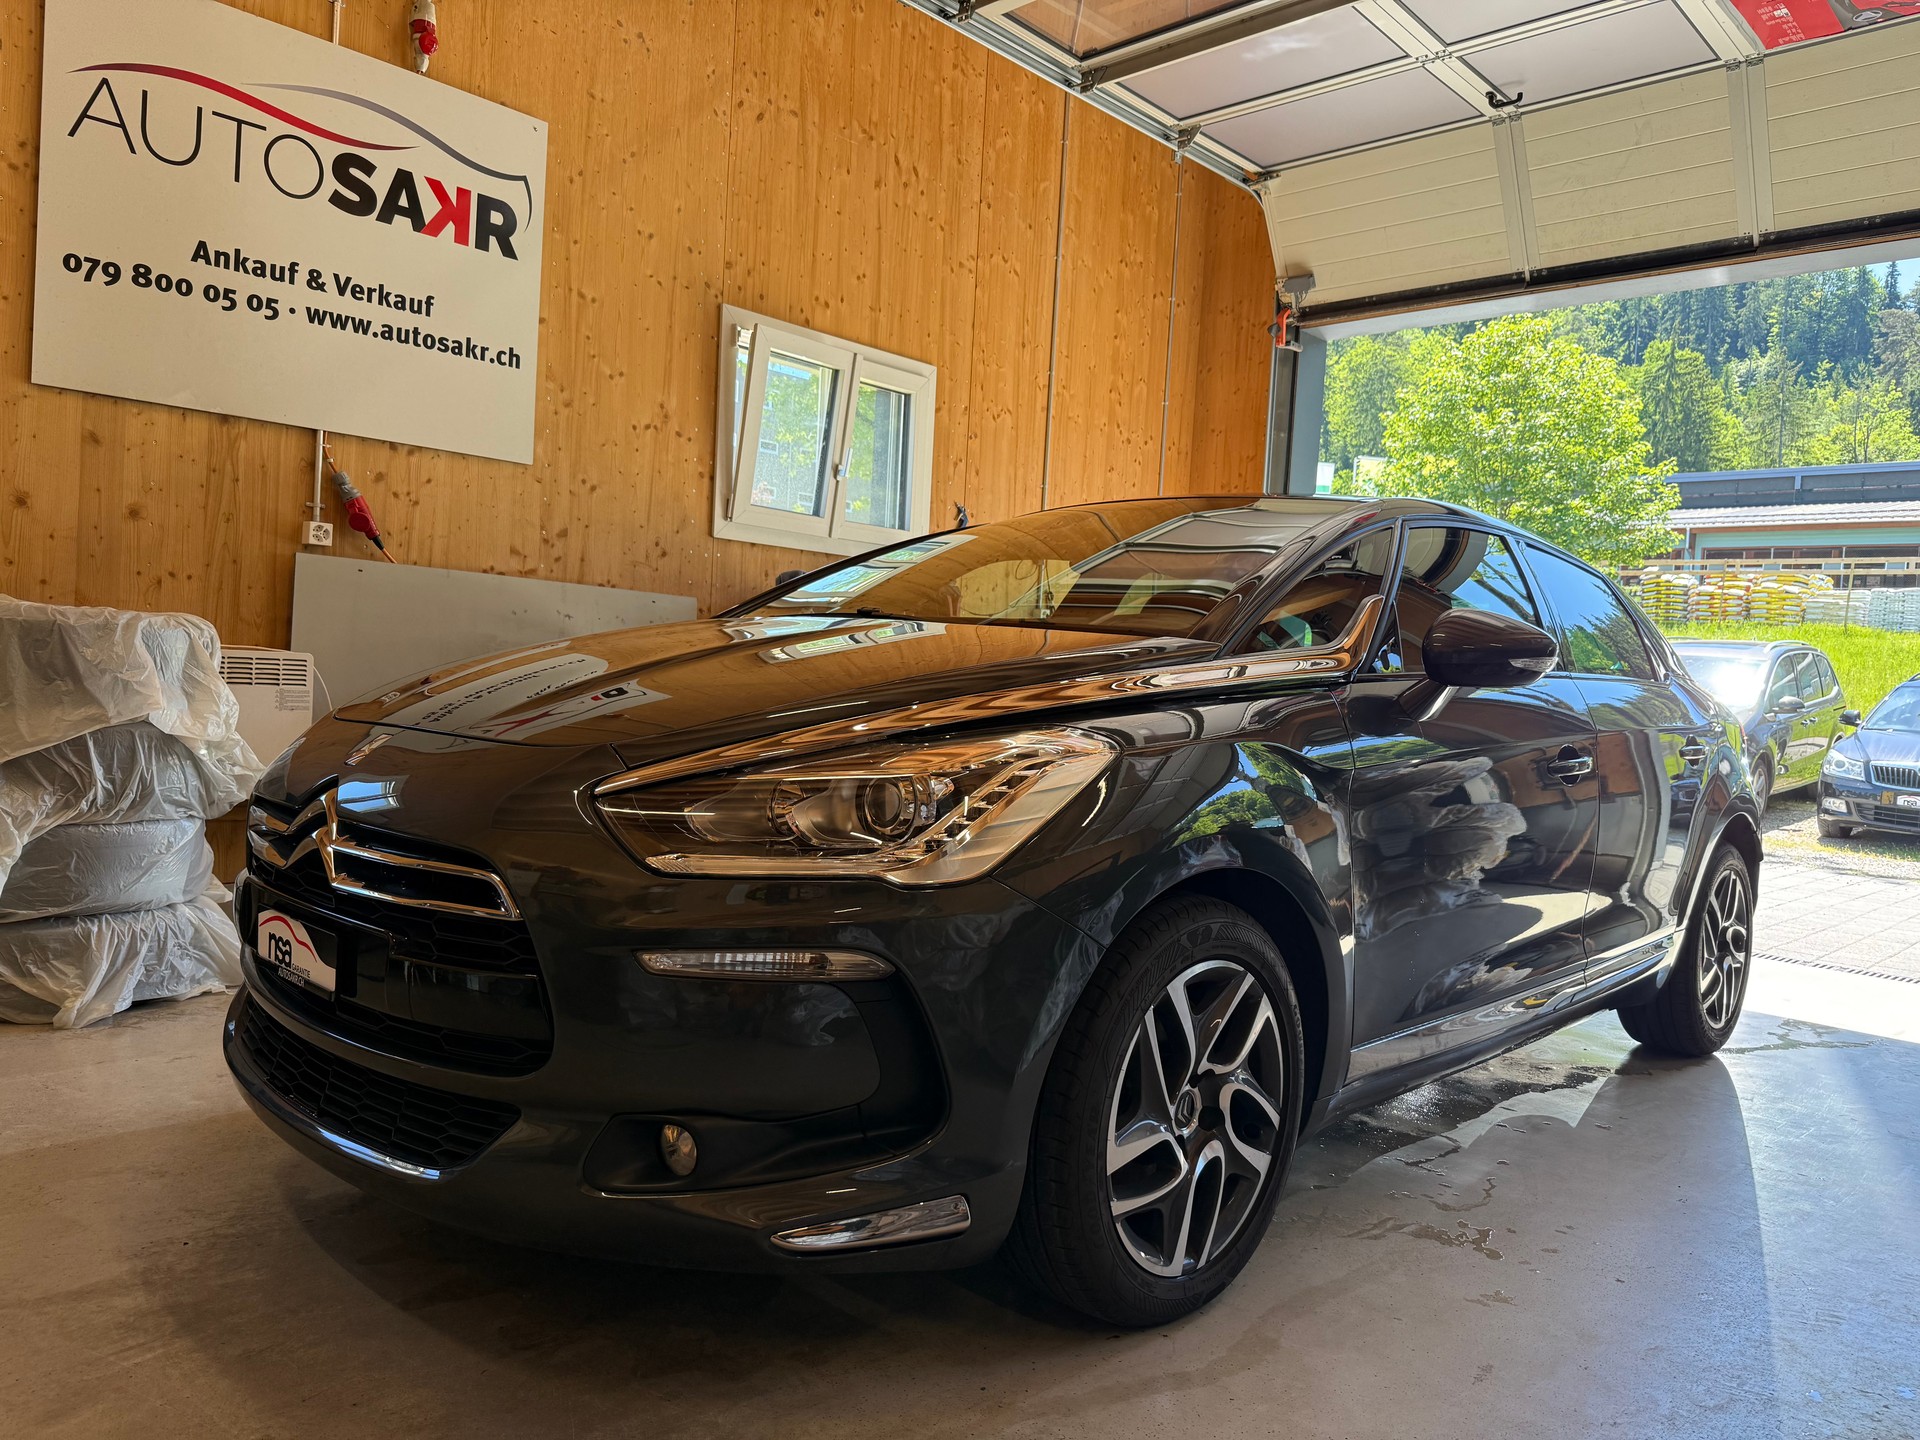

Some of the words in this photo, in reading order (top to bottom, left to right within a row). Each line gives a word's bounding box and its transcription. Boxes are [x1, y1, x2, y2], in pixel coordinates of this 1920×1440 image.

[190, 239, 299, 286] Ankauf
[306, 268, 328, 293] &
[333, 272, 435, 318] Verkauf
[62, 252, 122, 287] 079
[131, 263, 194, 297] 800
[202, 284, 238, 312] 05
[246, 293, 280, 321] 05
[305, 306, 521, 370] www.autosakr.ch
[268, 931, 292, 969] nsa
[292, 963, 311, 979] GARANTIE
